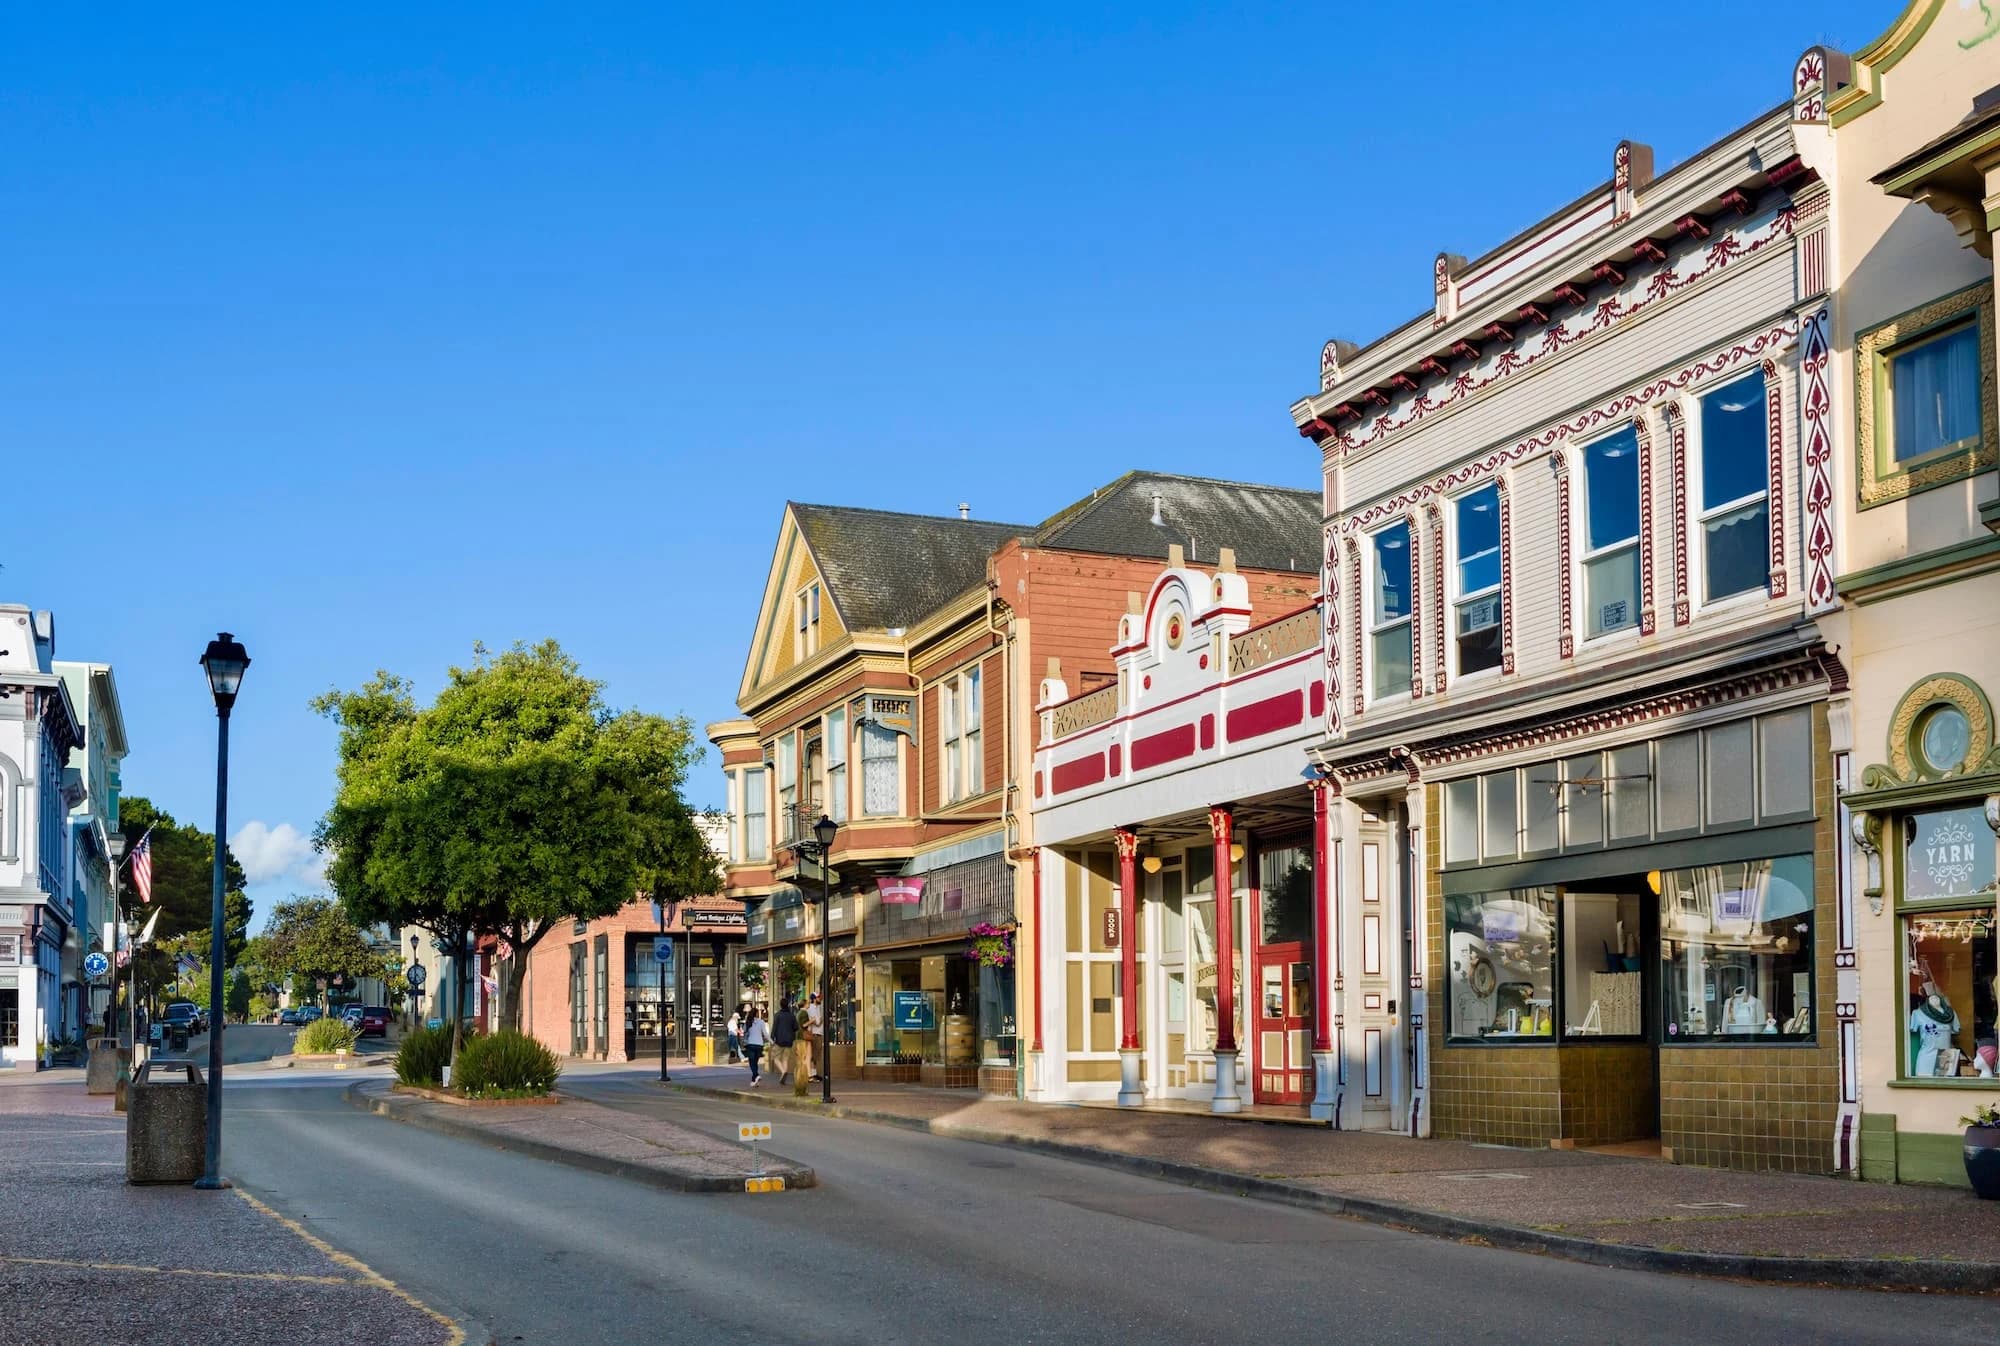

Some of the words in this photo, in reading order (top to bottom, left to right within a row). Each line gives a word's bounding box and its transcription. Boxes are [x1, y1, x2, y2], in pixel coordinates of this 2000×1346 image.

[1926, 843, 1975, 865] YARN
[1108, 912, 1116, 939] BOOKS
[93, 959, 100, 969] F
